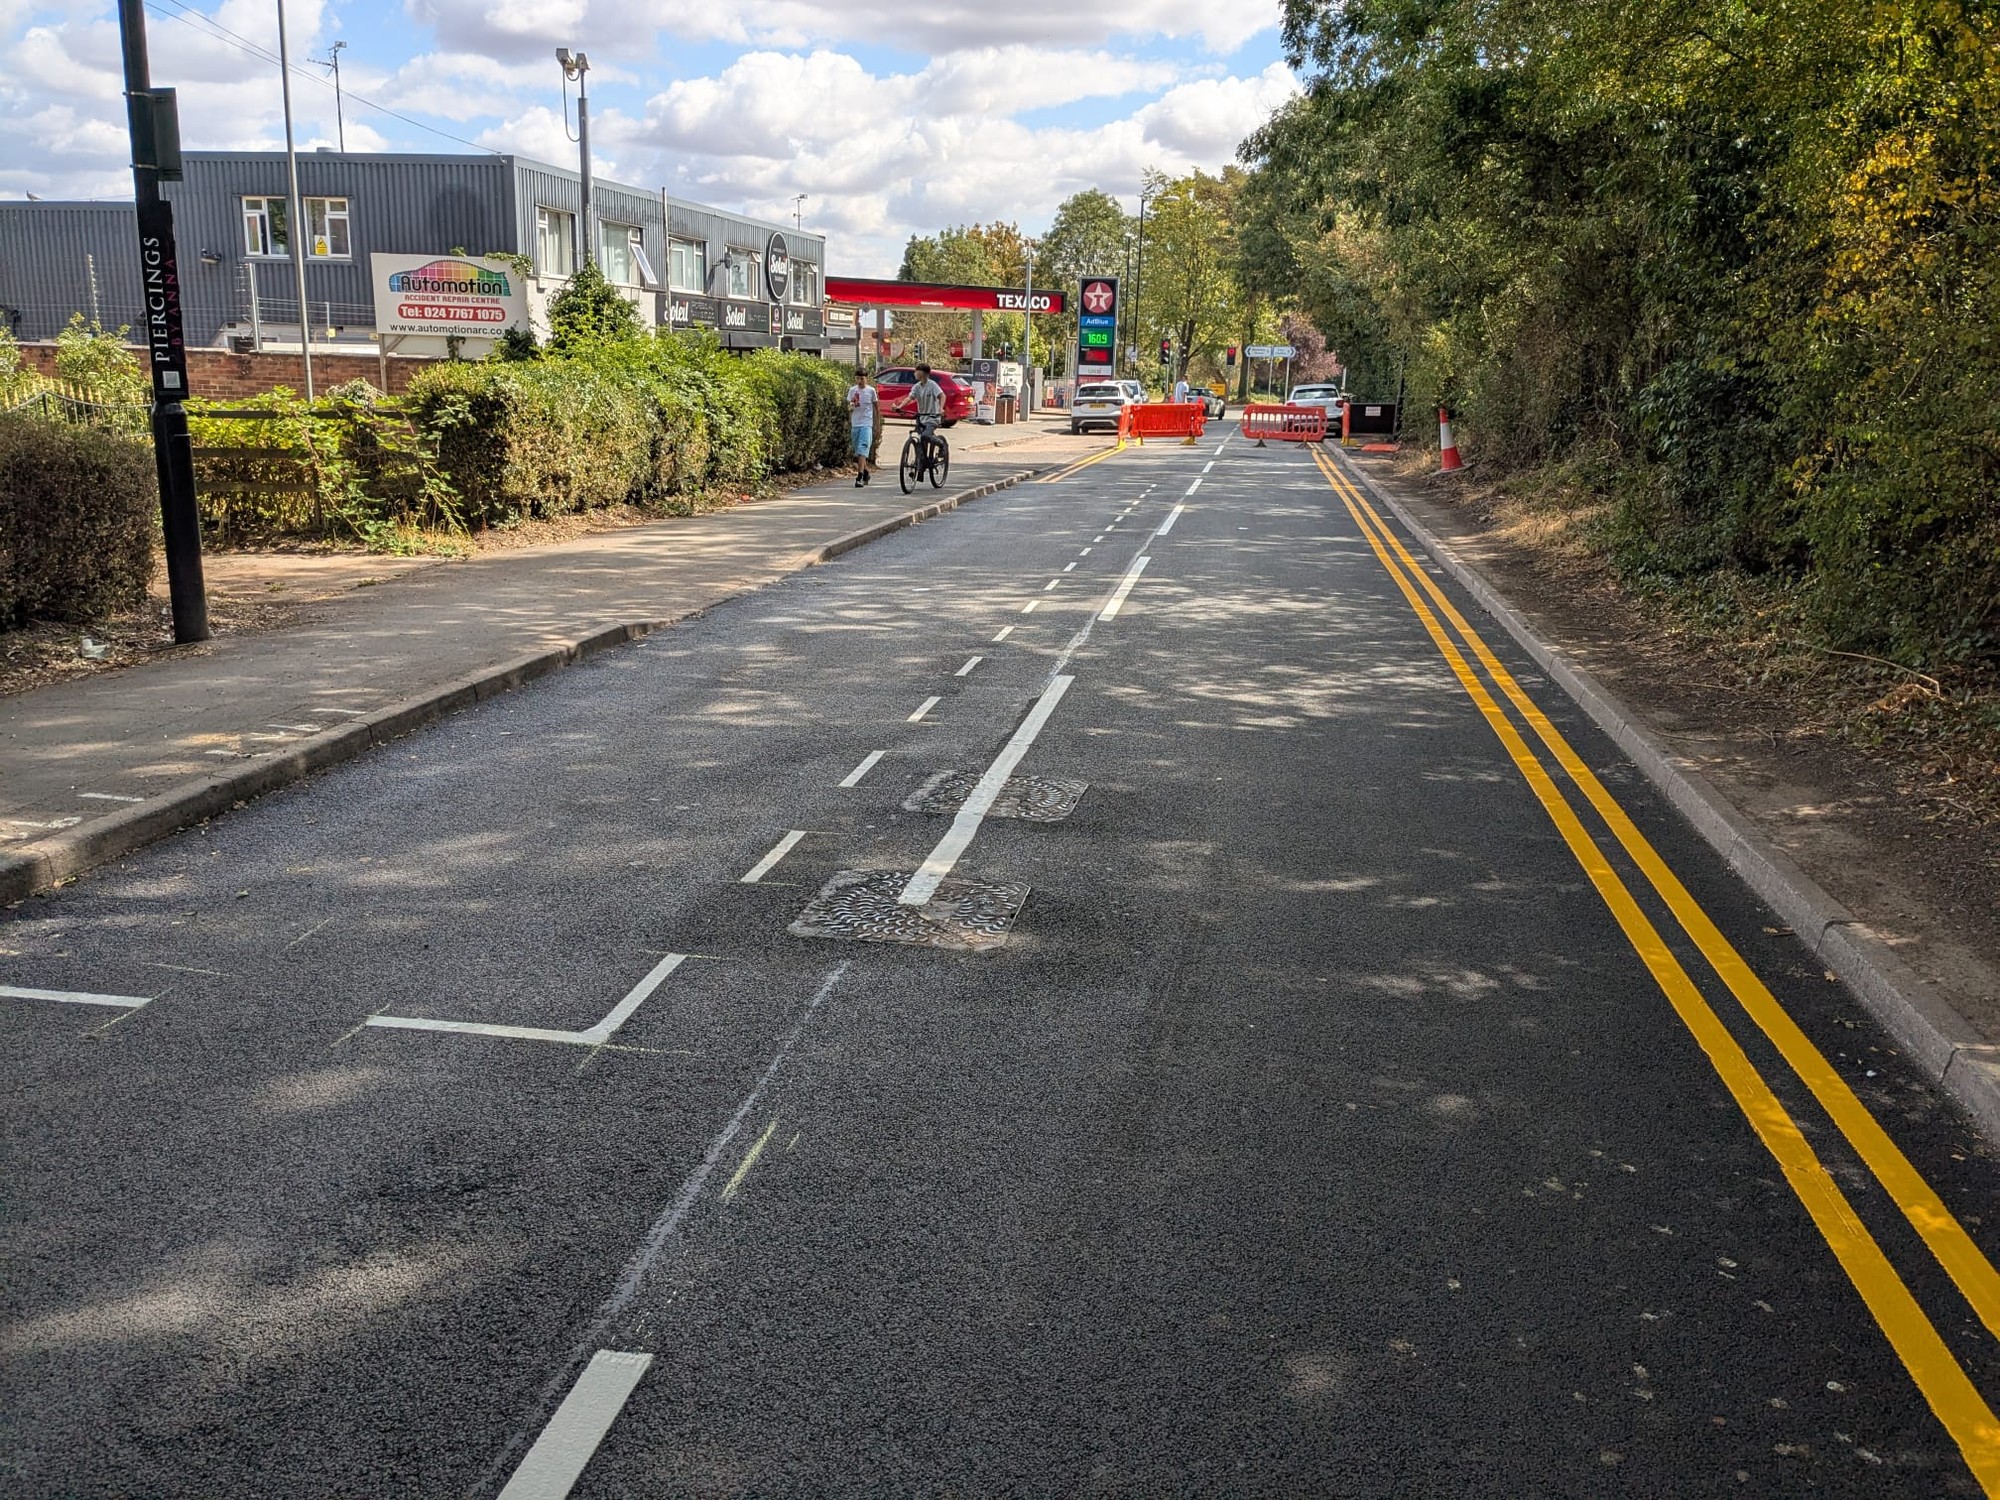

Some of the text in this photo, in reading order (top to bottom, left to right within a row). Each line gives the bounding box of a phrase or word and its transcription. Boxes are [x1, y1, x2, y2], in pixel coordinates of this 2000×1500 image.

[400, 275, 503, 295] Automotion
[143, 237, 171, 362] PIERCINGS
[404, 294, 440, 302] ACCIDENT
[442, 295, 470, 303] REPAIR
[400, 306, 503, 320] Tel: 024 7767 1075
[725, 304, 746, 327] Soleil
[389, 323, 505, 336] www.automotionarc.co.
